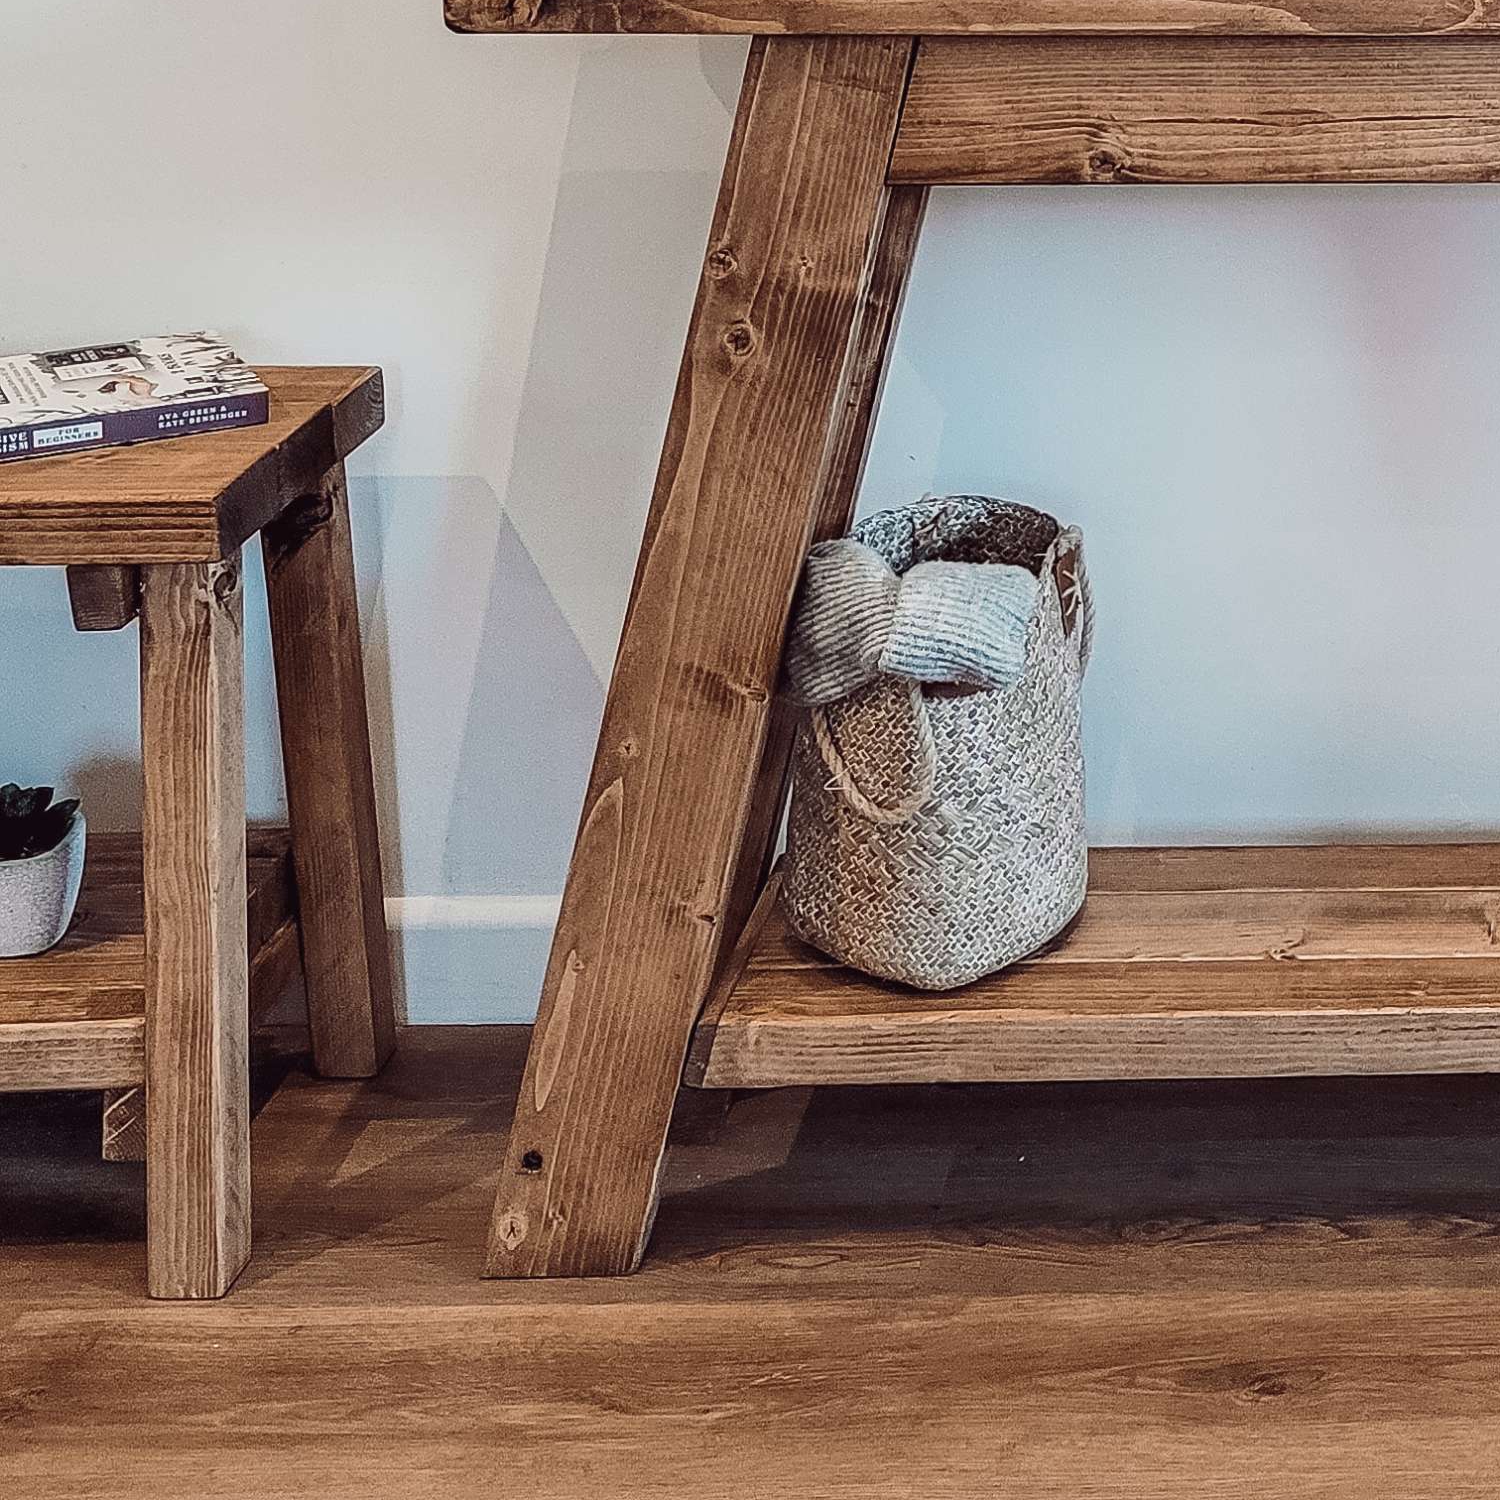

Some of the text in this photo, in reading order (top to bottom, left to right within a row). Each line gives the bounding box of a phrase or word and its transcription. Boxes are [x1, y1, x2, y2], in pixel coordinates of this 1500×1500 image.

[158, 412, 178, 421] AVA
[182, 406, 216, 418] GREEN
[158, 419, 184, 429] KATE
[58, 427, 79, 436] FOR
[37, 431, 99, 445] BEGINNERS
